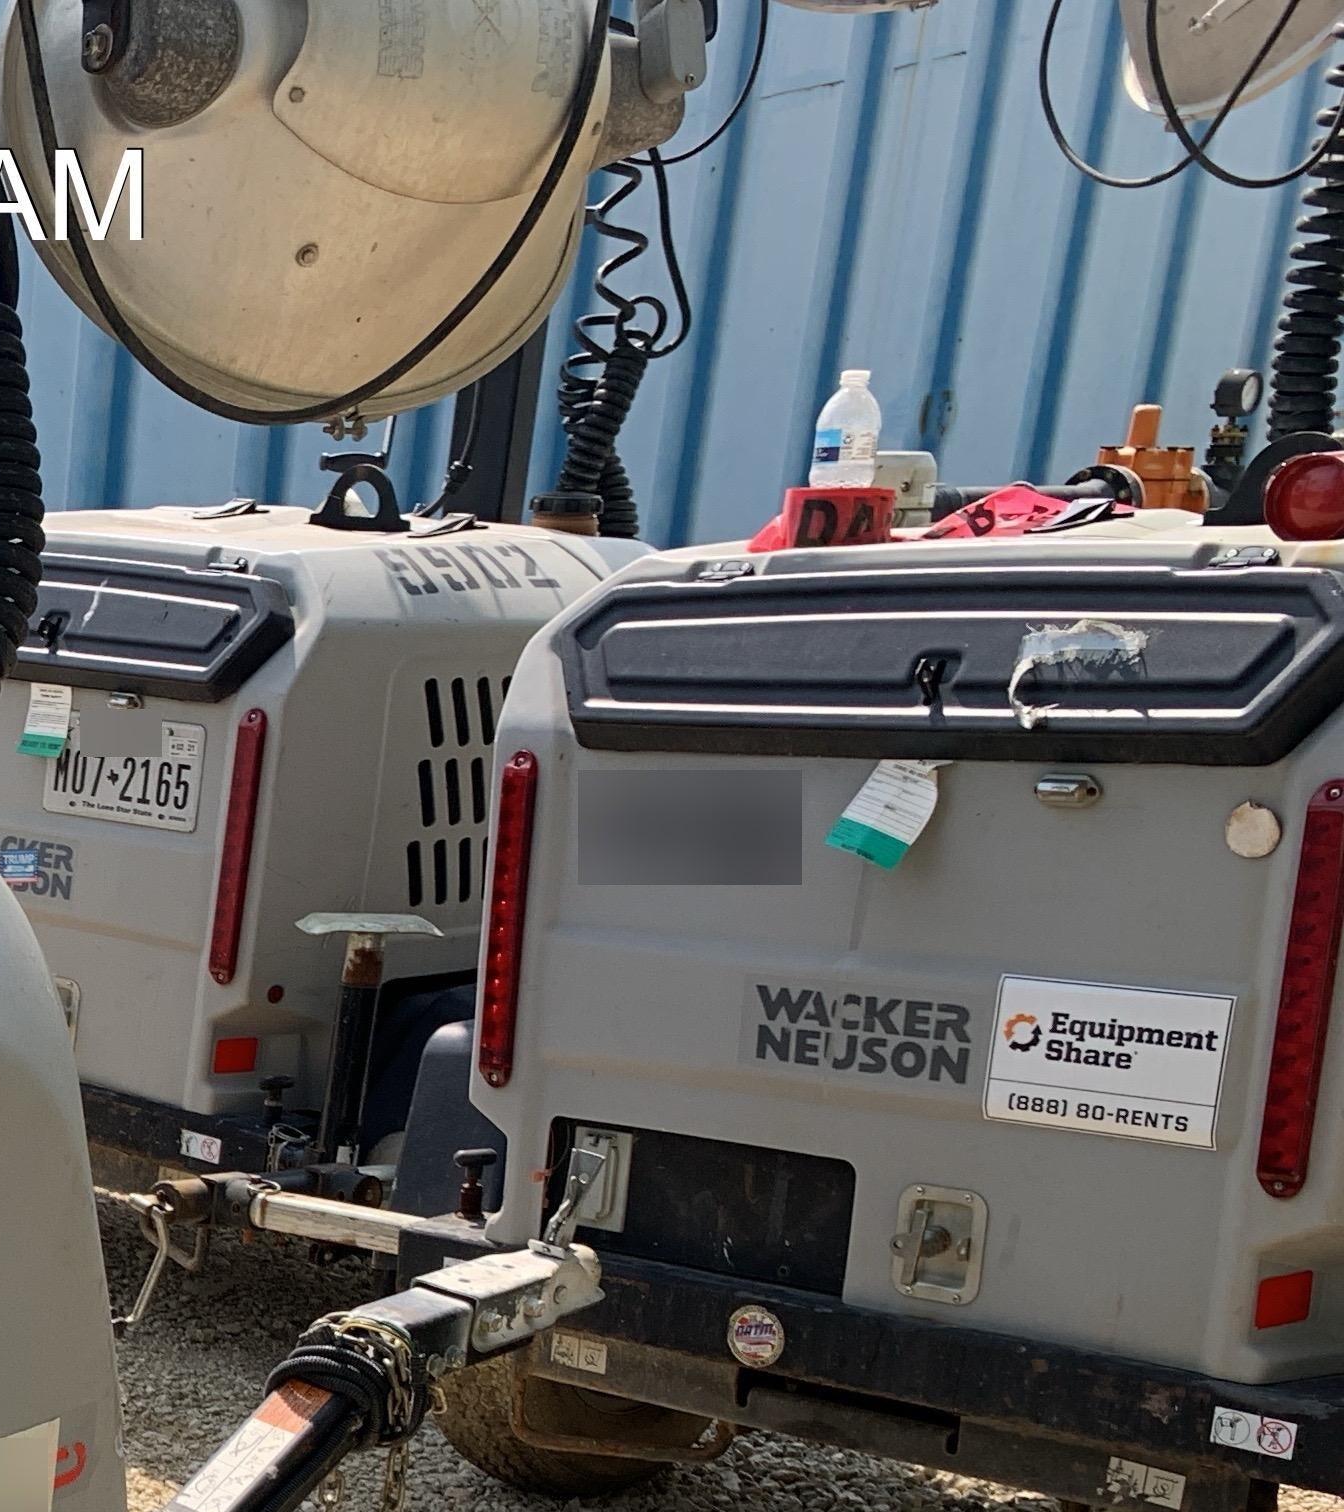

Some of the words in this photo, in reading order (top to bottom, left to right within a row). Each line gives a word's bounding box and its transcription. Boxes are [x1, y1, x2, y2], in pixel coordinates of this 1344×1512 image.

[82, 800, 97, 809] The
[97, 803, 115, 812] Lone
[116, 805, 131, 815] Star
[133, 808, 153, 818] State
[756, 984, 972, 1043] WACKER
[1049, 1012, 1219, 1052] Equipment
[755, 1023, 971, 1085] NEUSON
[1045, 1039, 1133, 1070] Share
[1008, 1092, 1068, 1117] (888)
[1076, 1103, 1190, 1133] 80-RENTS
